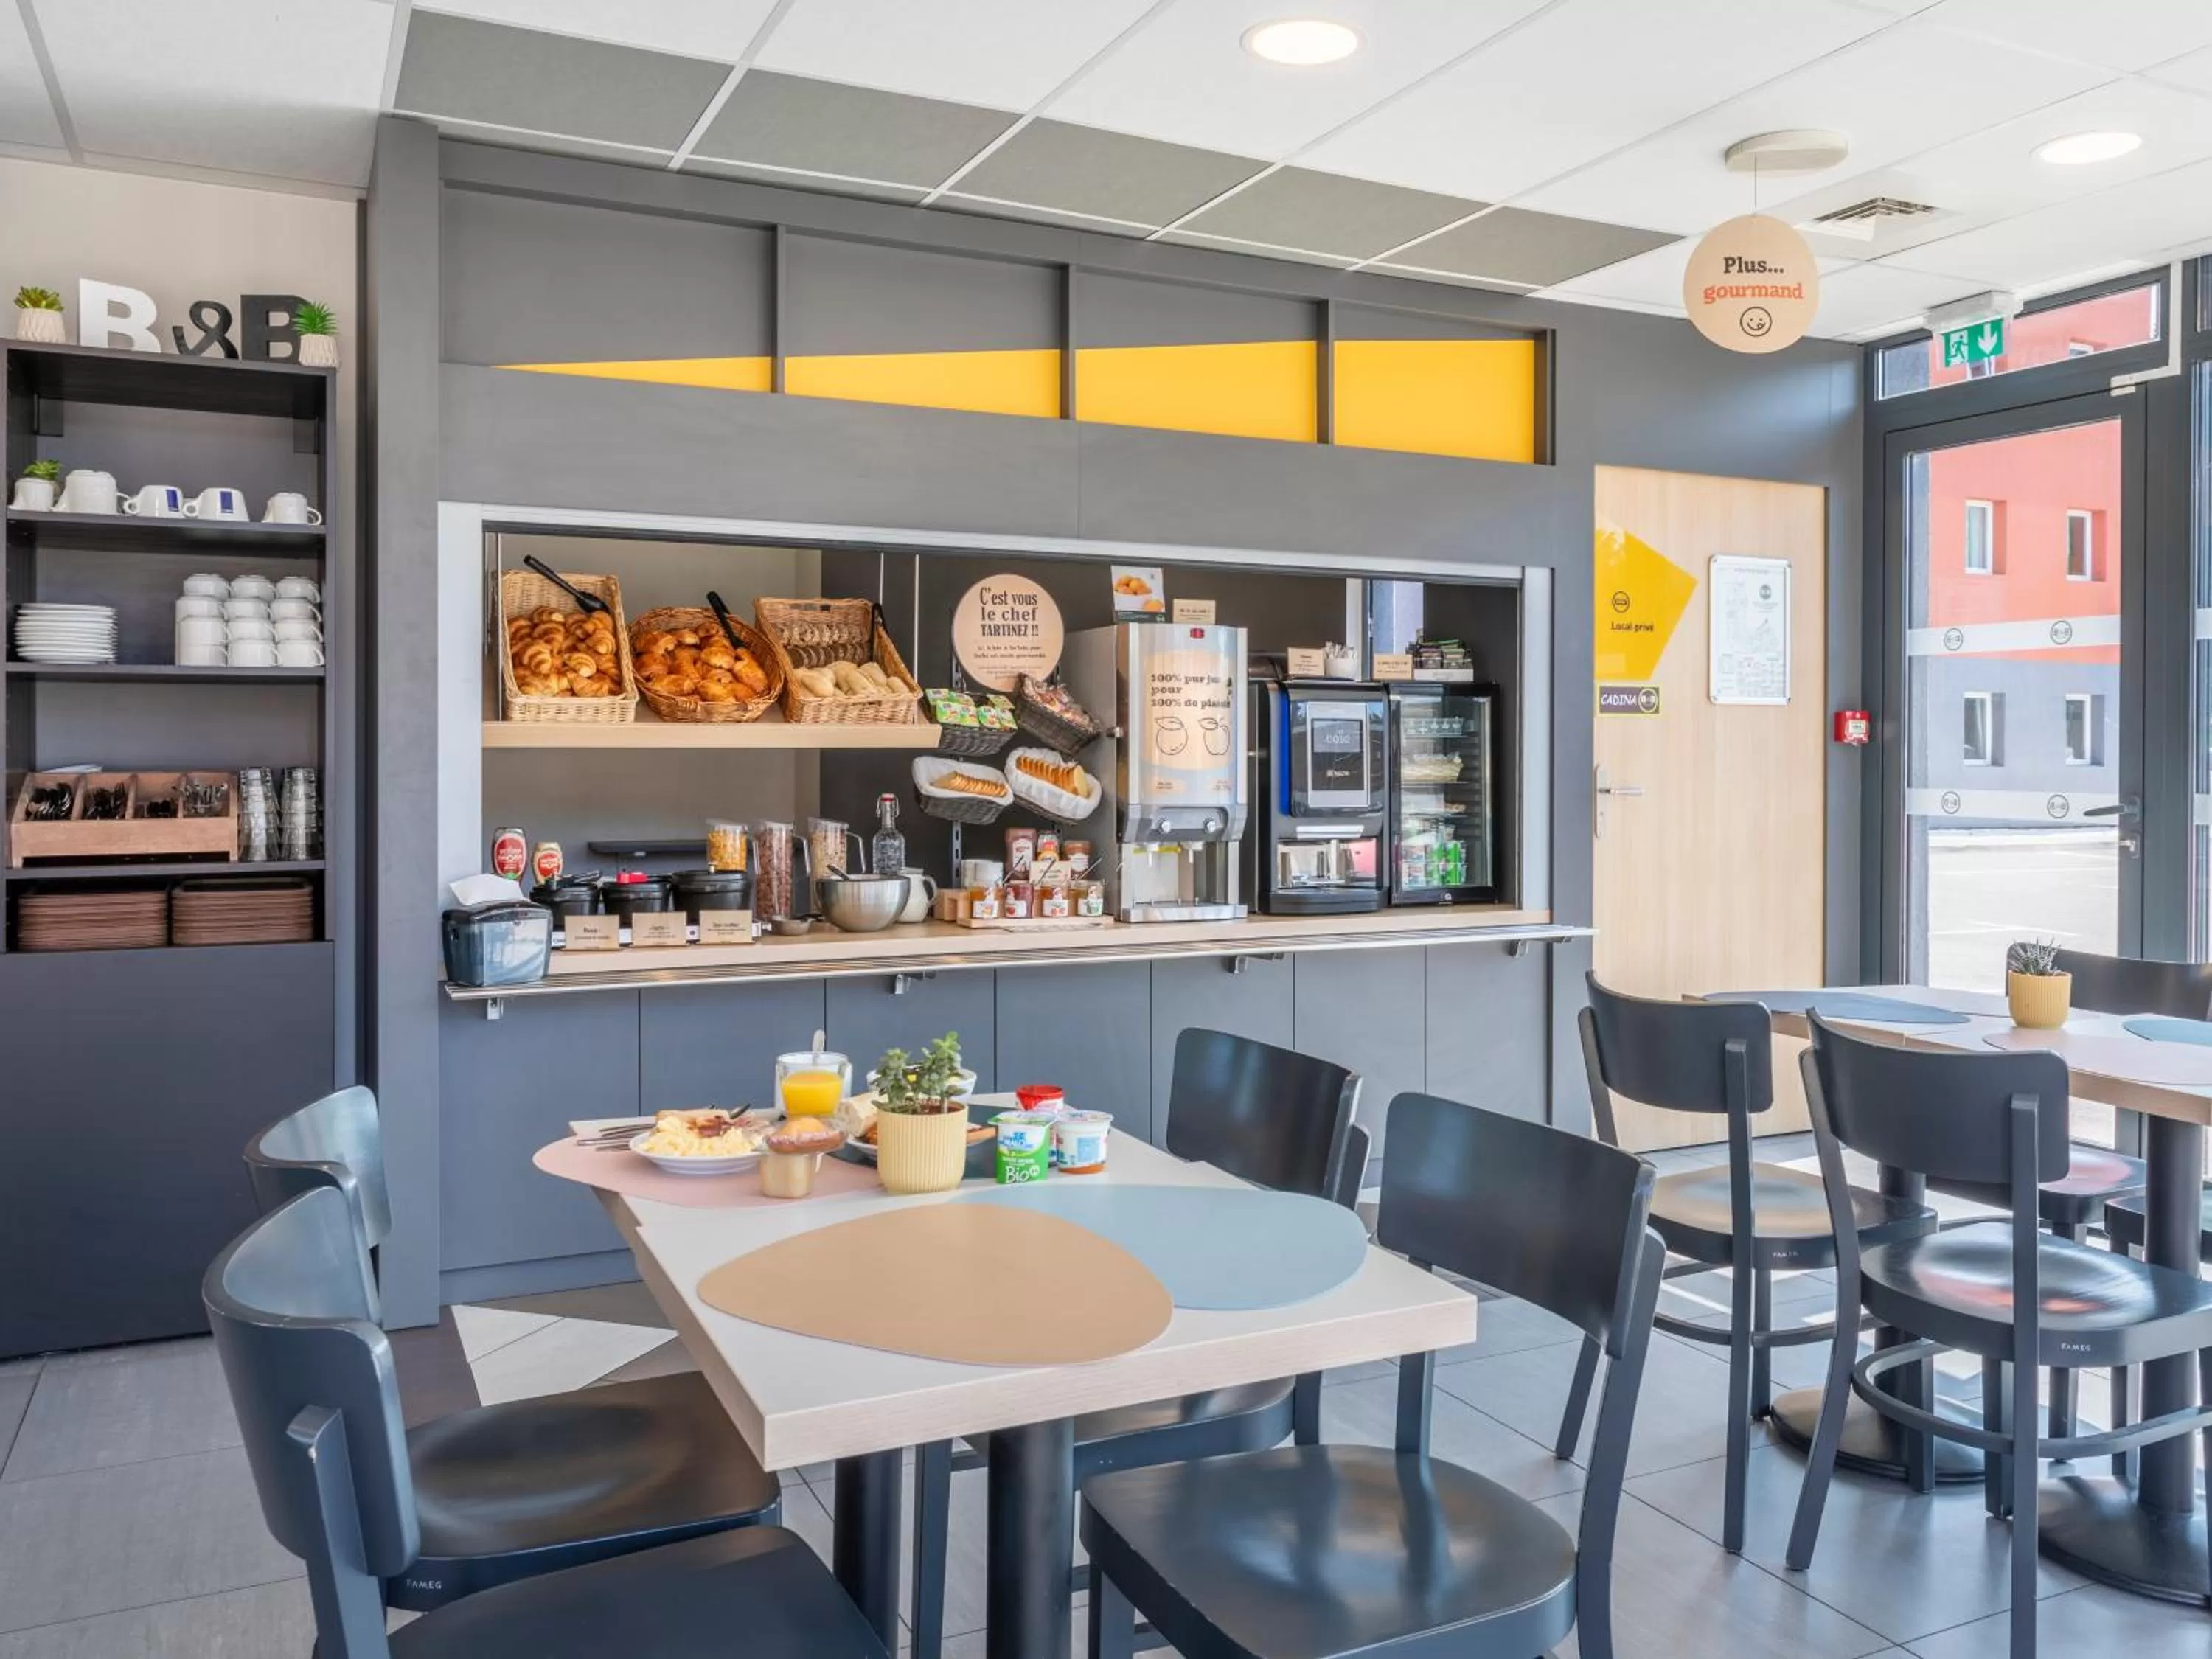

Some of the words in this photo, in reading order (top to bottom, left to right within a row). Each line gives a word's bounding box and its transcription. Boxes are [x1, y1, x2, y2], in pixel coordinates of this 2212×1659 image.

[1723, 257, 1784, 274] Plus...
[1703, 283, 1804, 304] gourmand
[980, 587, 1009, 605] C'est
[1011, 593, 1037, 605] vous
[981, 606, 995, 621] le
[1002, 606, 1038, 621] chef
[981, 624, 1028, 637] TARTINEZ
[1610, 621, 1632, 630] Local
[1151, 674, 1182, 683] 100%
[1184, 675, 1205, 684] pur
[1151, 686, 1182, 696] pour
[1151, 698, 1182, 707] 100%
[1184, 698, 1198, 707] de
[1601, 694, 1637, 707] CADINA
[1006, 1166, 1030, 1183] Bio
